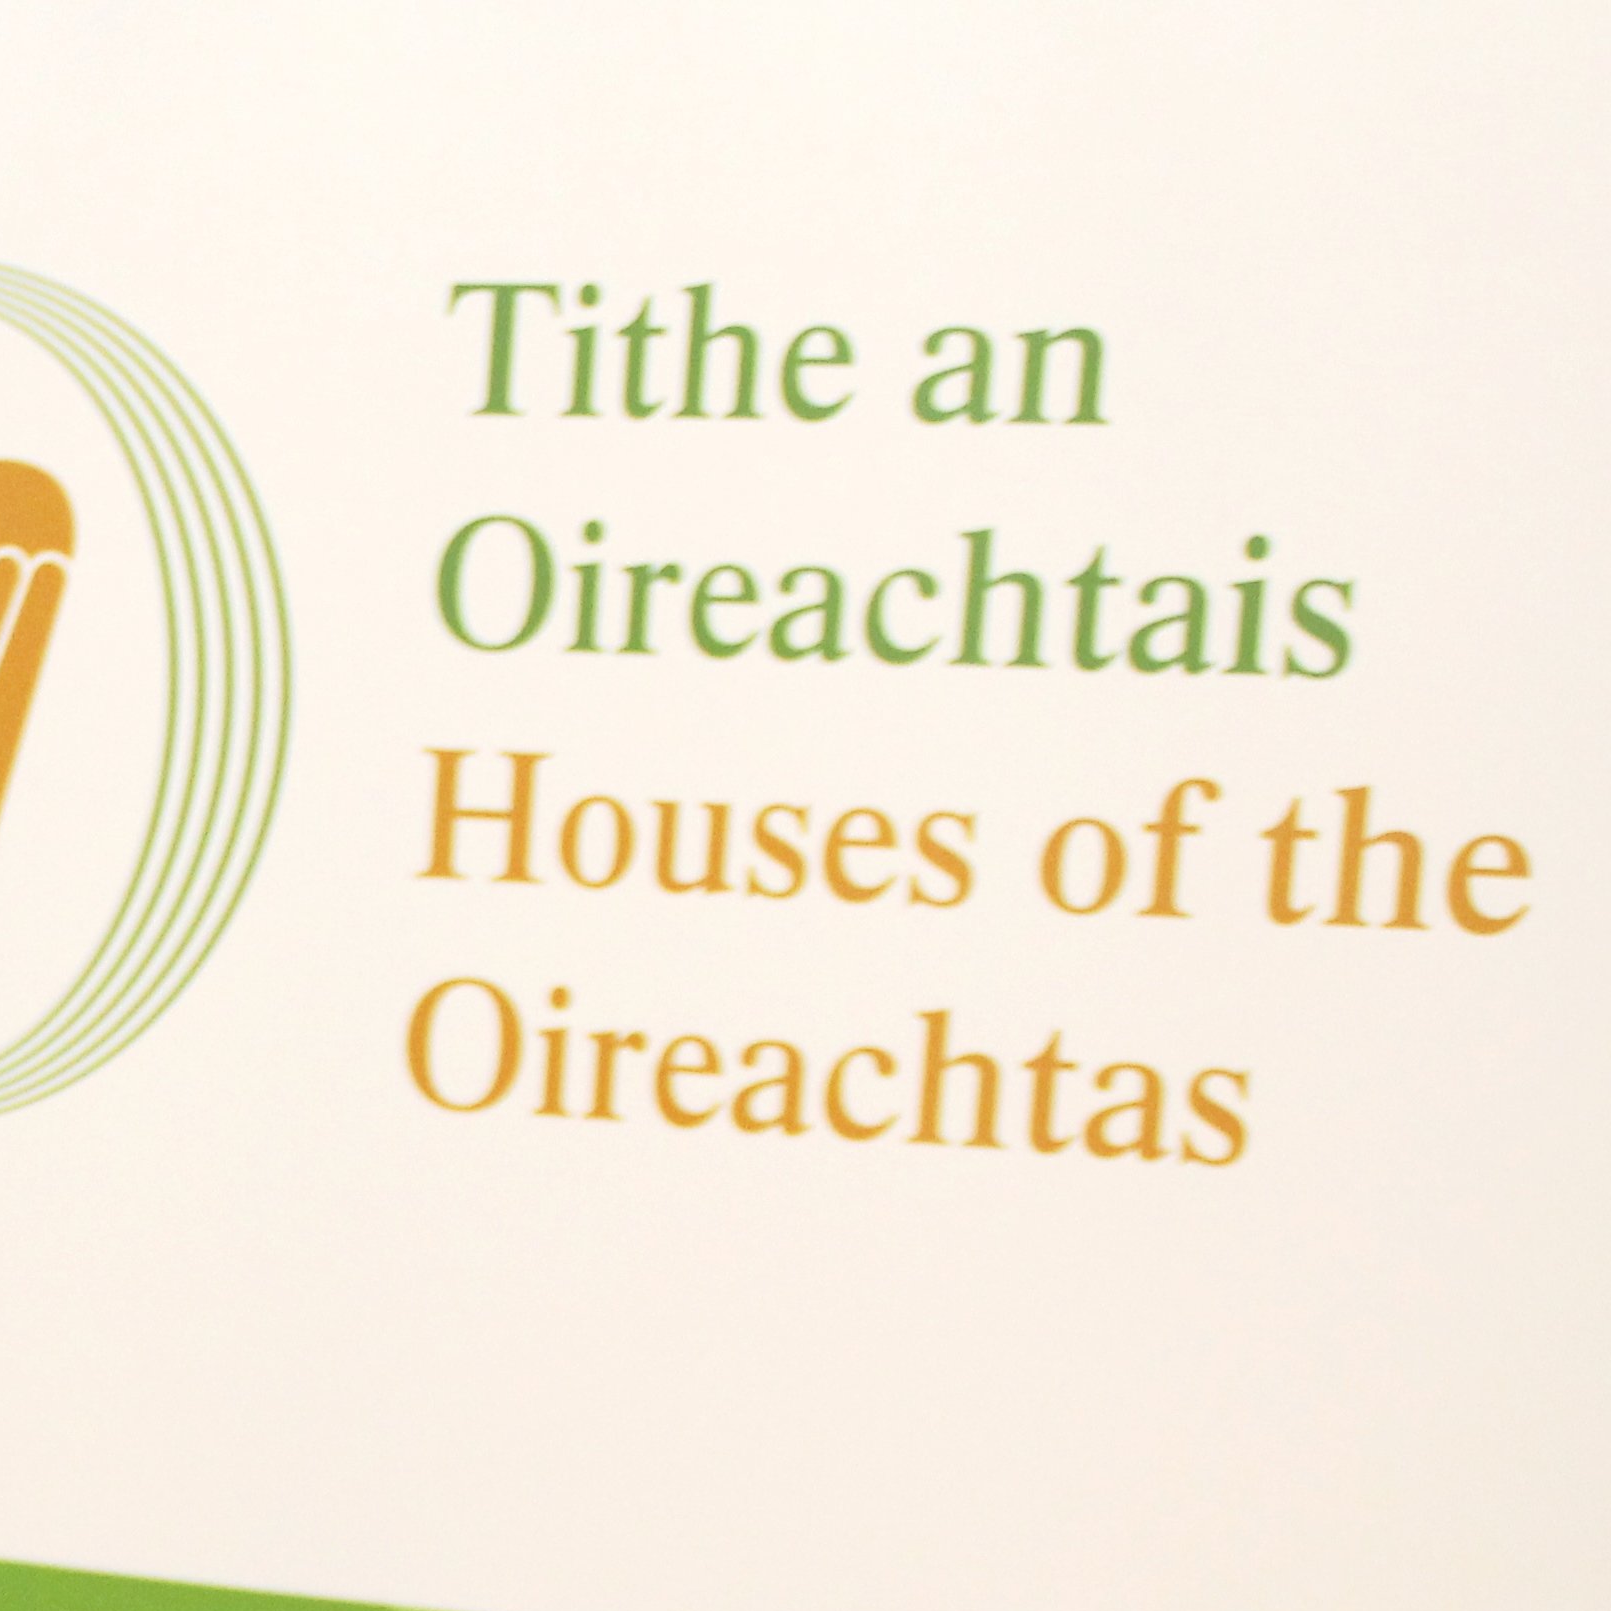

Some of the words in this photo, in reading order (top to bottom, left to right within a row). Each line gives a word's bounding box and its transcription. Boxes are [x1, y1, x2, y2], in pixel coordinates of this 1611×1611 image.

[451, 284, 852, 422] Tithe
[913, 328, 1106, 424] an
[437, 516, 1351, 678] Oireachtais
[416, 748, 975, 909] Houses
[1039, 777, 1222, 919] of
[1260, 785, 1531, 936] the
[405, 977, 1249, 1167] Oireachtas
